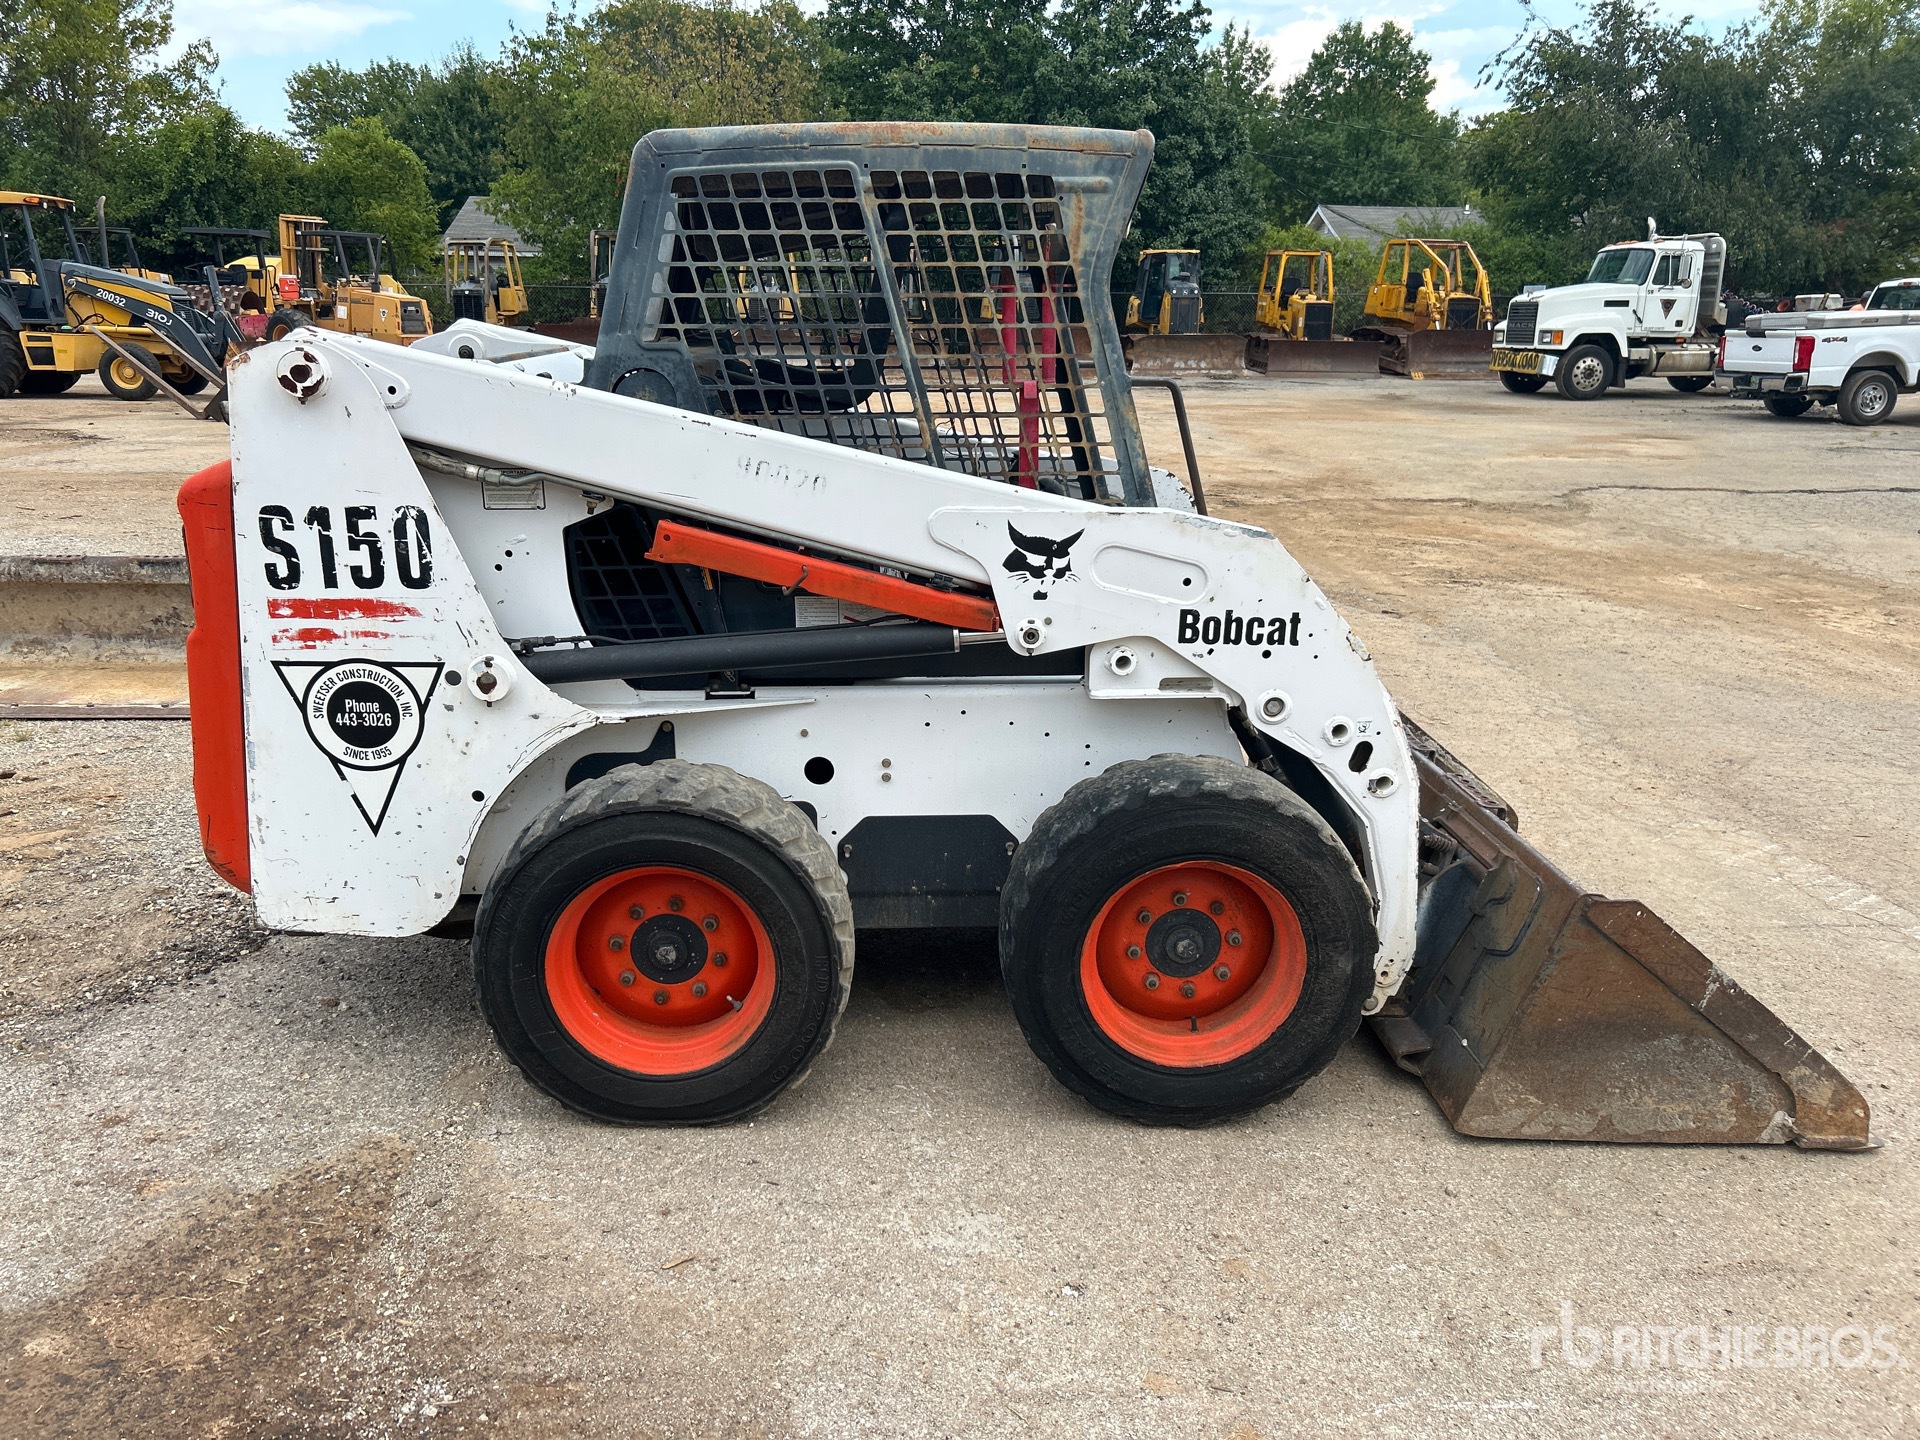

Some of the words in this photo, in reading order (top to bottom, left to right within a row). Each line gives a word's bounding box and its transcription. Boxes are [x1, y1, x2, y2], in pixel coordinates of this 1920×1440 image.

[96, 288, 126, 307] 20032
[145, 308, 173, 325] 310J
[258, 505, 434, 590] S150
[1178, 609, 1301, 646] Bobcat
[313, 677, 337, 719] SWEETSER
[336, 669, 405, 701] CONSTRUCTION,
[400, 702, 413, 720] INC.
[344, 698, 380, 713] Phone
[335, 712, 392, 726] 443-3026
[343, 746, 370, 760] SINCE
[371, 746, 392, 760] 1955
